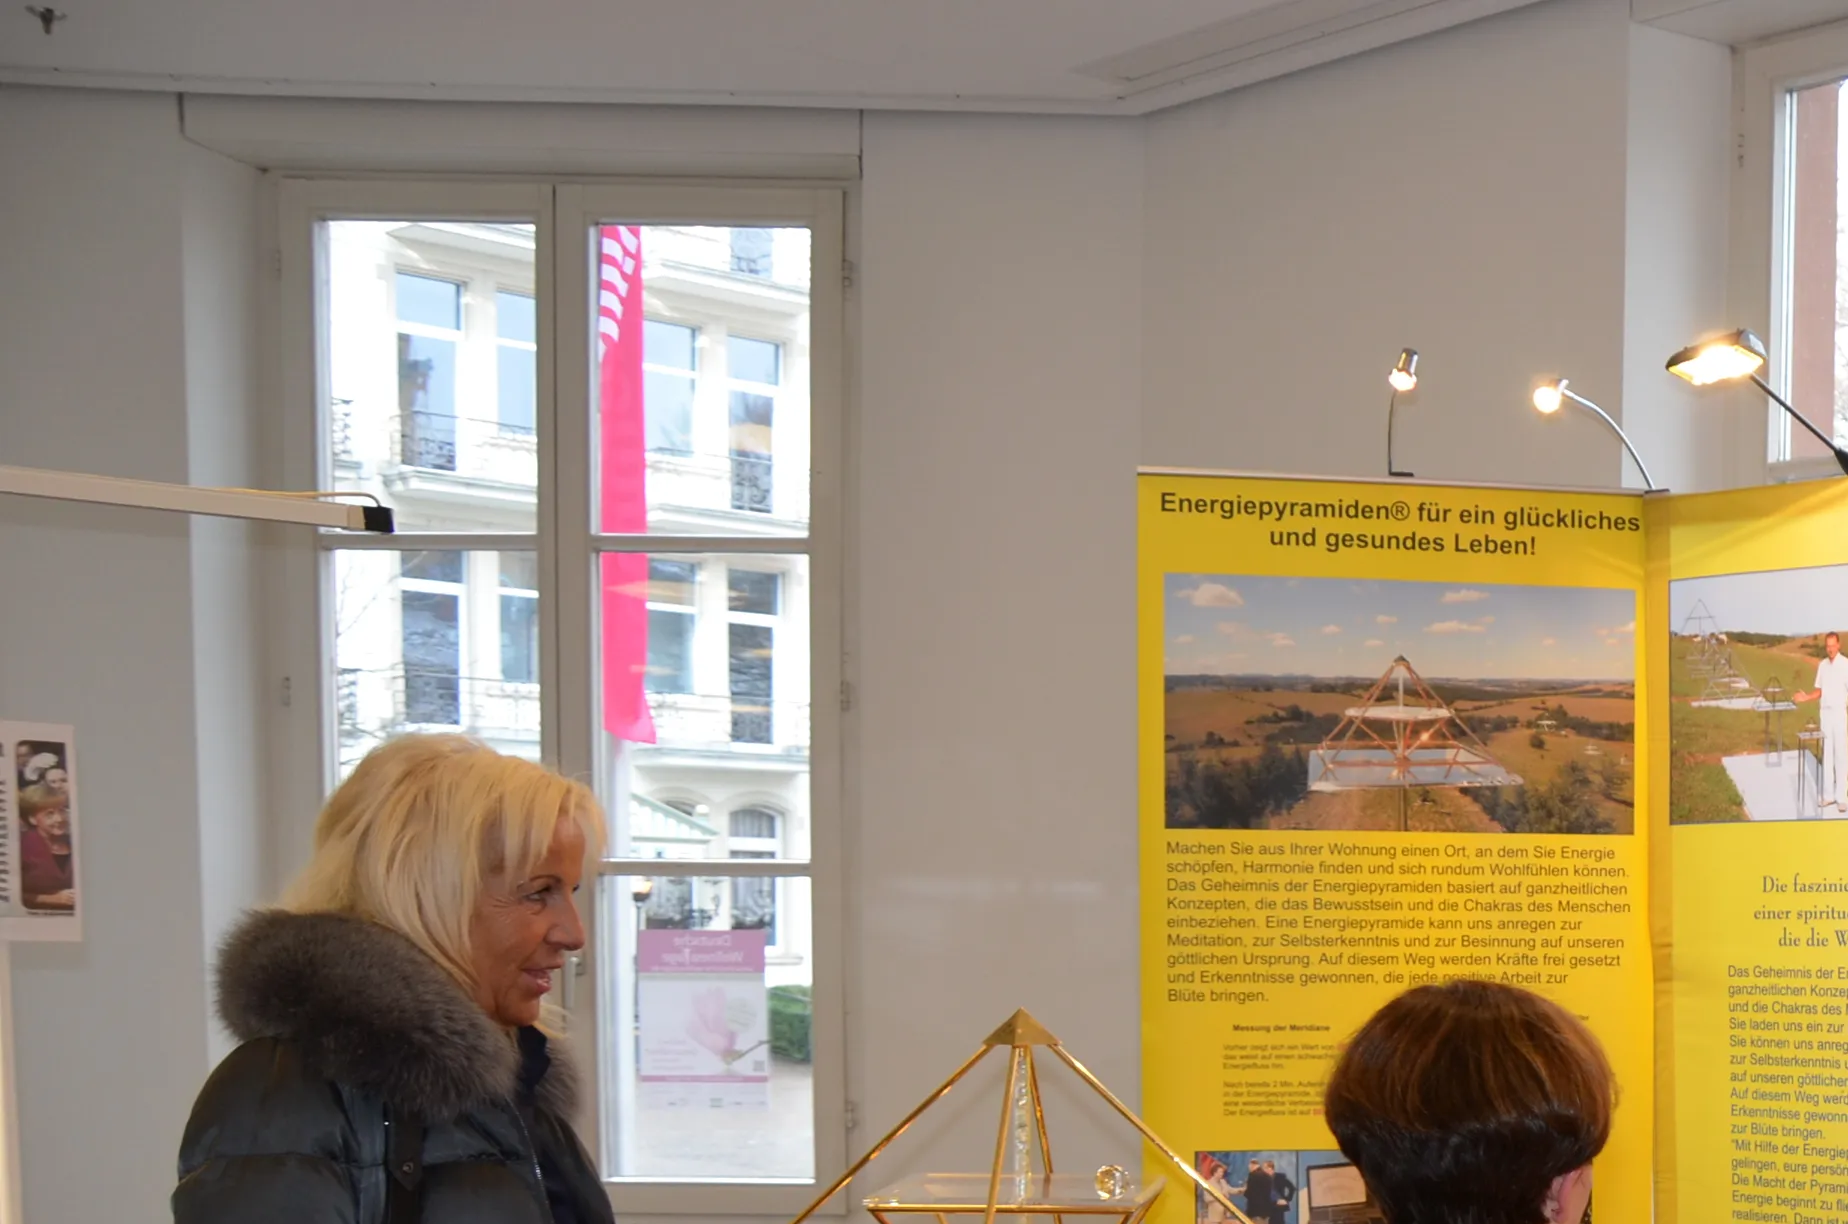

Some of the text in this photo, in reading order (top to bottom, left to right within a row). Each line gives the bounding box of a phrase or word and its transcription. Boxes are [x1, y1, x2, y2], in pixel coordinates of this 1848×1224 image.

[1418, 501, 1452, 525] für
[1460, 504, 1496, 526] ein
[1504, 507, 1641, 532] glückliches
[1270, 527, 1536, 556] und gesundes Leben!
[1166, 840, 1616, 863] Machen Sie aus Ihrer Wohnung einen Ort, an dem Sie Energie
[1167, 861, 1630, 879] schöpfen, Harmonie finden und sich rundum Wohlfühlen können.
[1762, 875, 1788, 893] Die
[1754, 904, 1792, 921] einer
[1778, 926, 1801, 947] die
[1805, 926, 1829, 948] die
[1727, 964, 1750, 978] Das
[1752, 964, 1813, 980] Geheimnis
[1815, 966, 1835, 980] der
[1167, 988, 1269, 1005] Blüte bringen.
[1727, 983, 1807, 1004] ganzheitlichen
